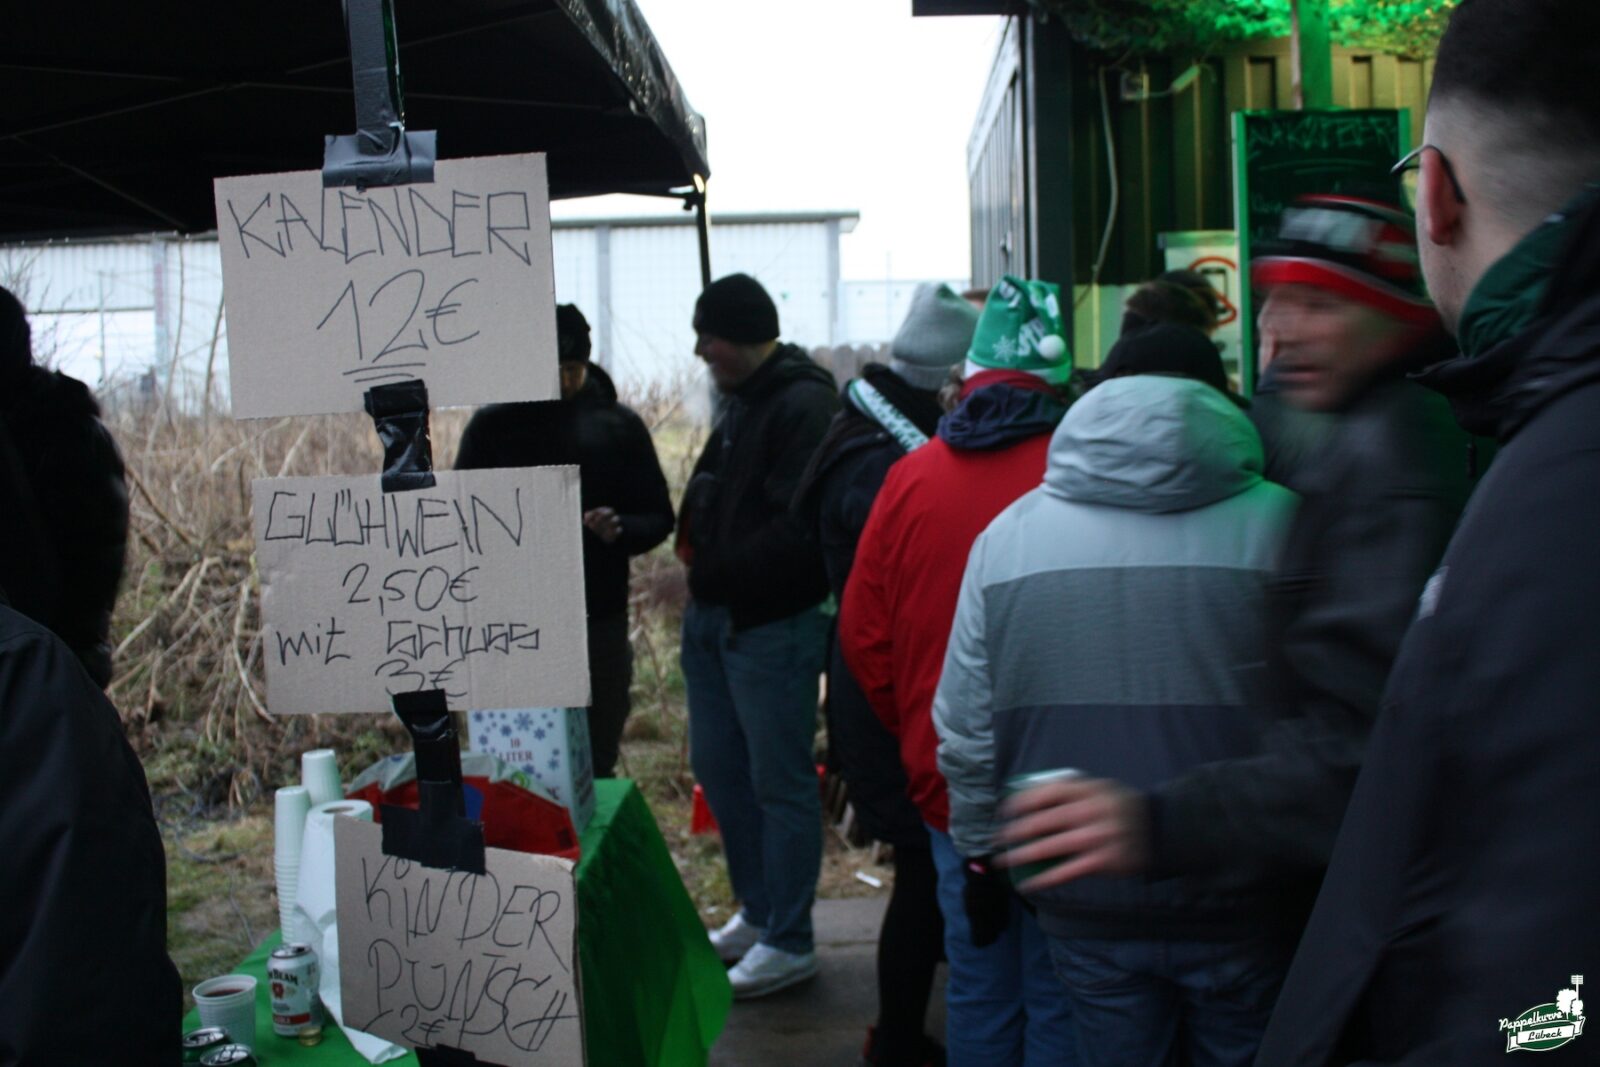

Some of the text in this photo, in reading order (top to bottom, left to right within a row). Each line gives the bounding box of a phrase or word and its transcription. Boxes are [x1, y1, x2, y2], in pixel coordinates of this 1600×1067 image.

[227, 188, 531, 266] KALENDER
[317, 269, 480, 363] 12€
[265, 488, 522, 557] GLÜHWEIN
[342, 563, 480, 616] 2,50€
[276, 617, 351, 665] mit
[375, 659, 468, 699] 3€
[362, 938, 578, 1051] PUNSCH
